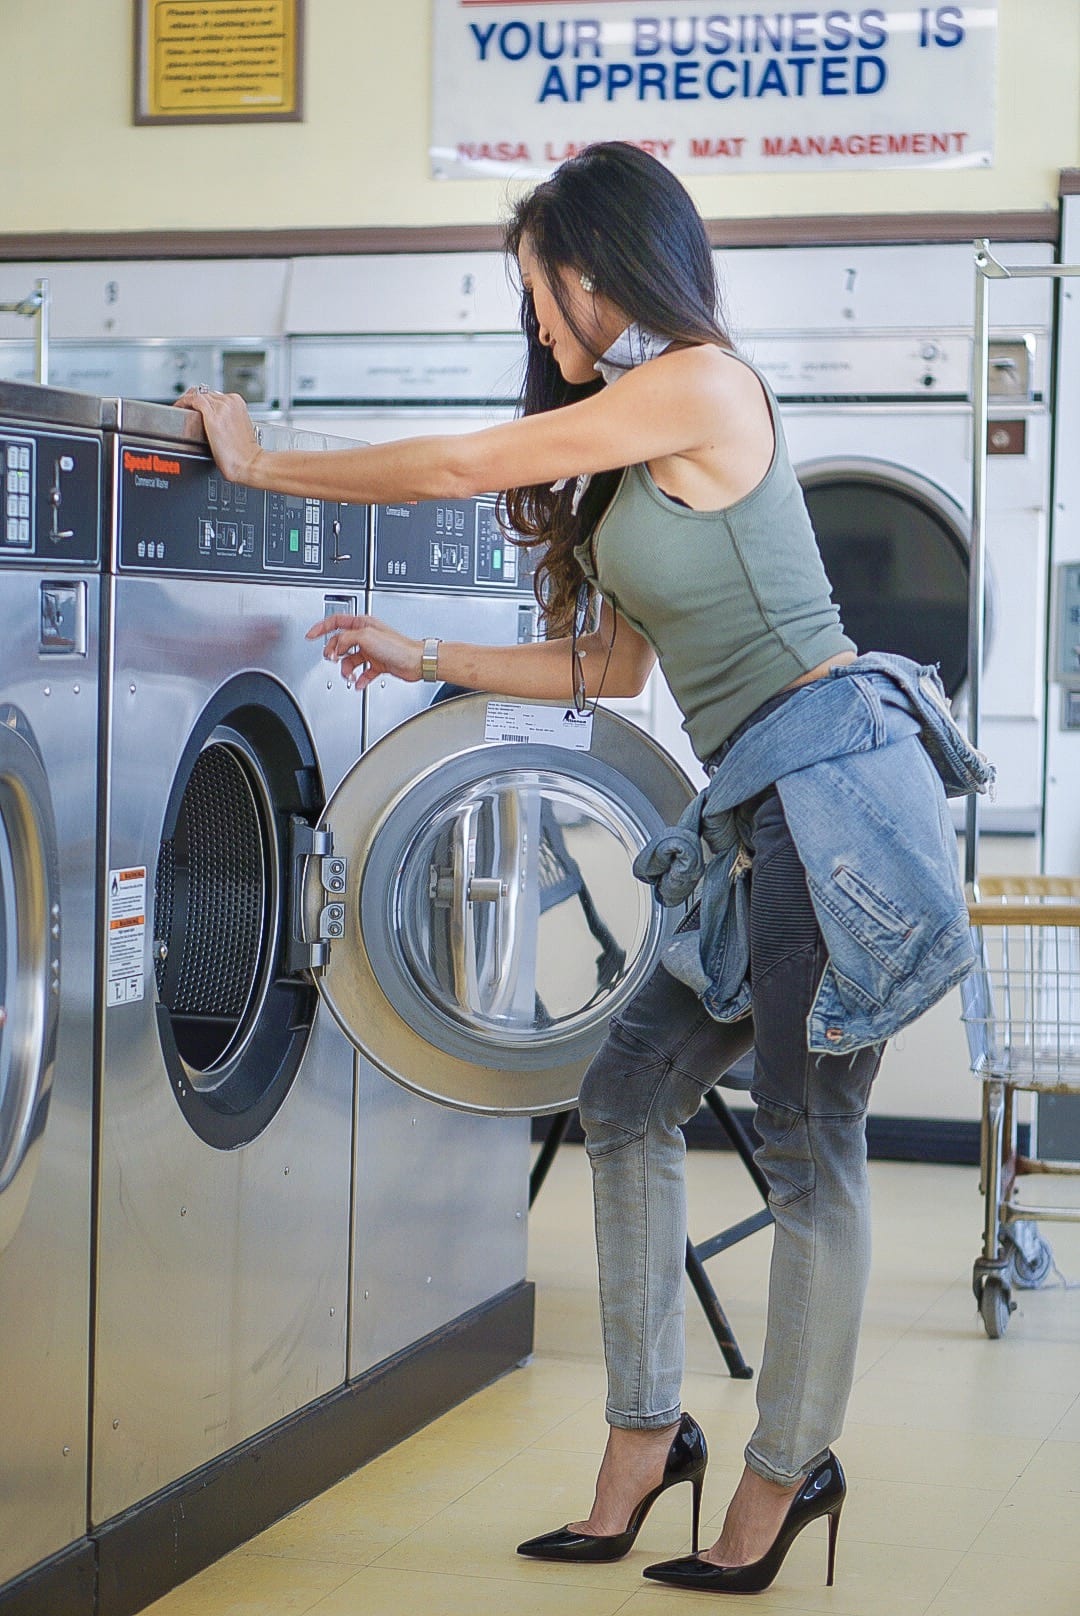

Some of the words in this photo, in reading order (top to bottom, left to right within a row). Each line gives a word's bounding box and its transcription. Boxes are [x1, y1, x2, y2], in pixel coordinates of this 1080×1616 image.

[469, 19, 603, 62] YOUR
[632, 10, 889, 59] BUSINESS
[918, 7, 965, 49] IS
[537, 54, 889, 104] APPRECIATED
[457, 141, 533, 161] NASA
[690, 137, 746, 158] MAT
[763, 131, 968, 157] MANAGEMENT
